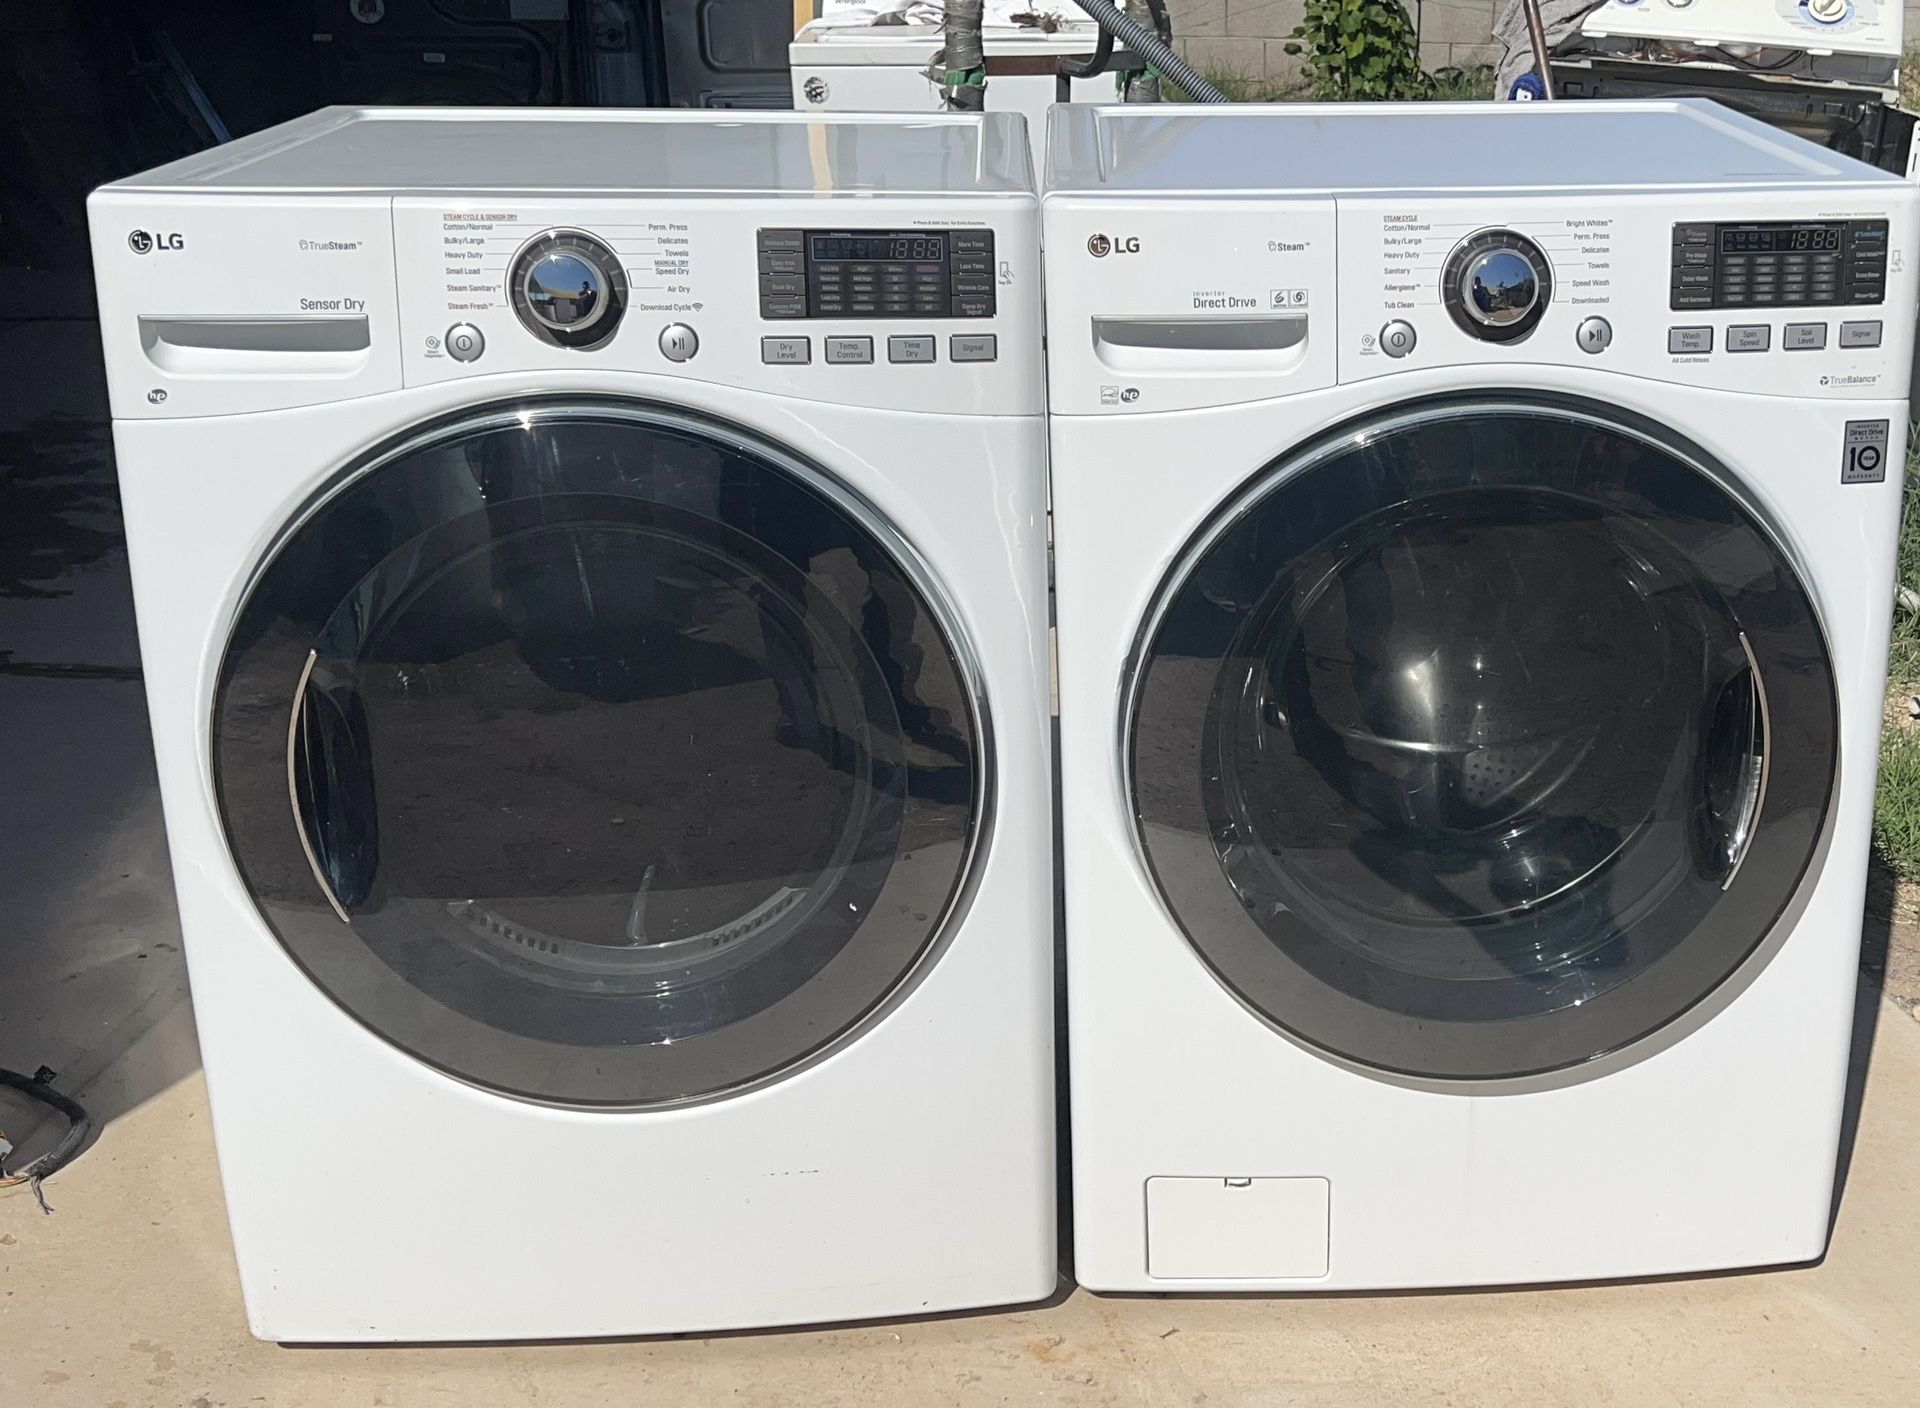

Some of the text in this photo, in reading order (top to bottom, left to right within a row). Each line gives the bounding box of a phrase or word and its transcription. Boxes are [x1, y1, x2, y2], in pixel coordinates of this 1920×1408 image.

[443, 223, 494, 231] Cotton/Normal
[1566, 220, 1585, 228] Bright
[156, 233, 184, 250] LG
[444, 237, 485, 245] Bulky/Large
[657, 237, 689, 245] Delicates
[1114, 237, 1140, 253] LG
[1383, 237, 1422, 245] Bulky/Large
[445, 251, 483, 259] Heavy Duty
[1384, 267, 1411, 275] Sanitary
[678, 286, 691, 294] Dry
[300, 298, 365, 312] Sensor Dry
[1193, 296, 1257, 309] Direct Drive
[673, 304, 692, 312] Cycle
[1681, 332, 1701, 340] Wash
[1743, 330, 1757, 339] Spin
[1800, 328, 1812, 336] Soil
[1852, 330, 1871, 339] Signal
[1739, 338, 1760, 348] Speed
[1797, 337, 1815, 345] Level
[962, 343, 984, 353] Signal
[837, 350, 864, 358] Control
[905, 350, 919, 359] Dry
[1850, 445, 1880, 471] 10
